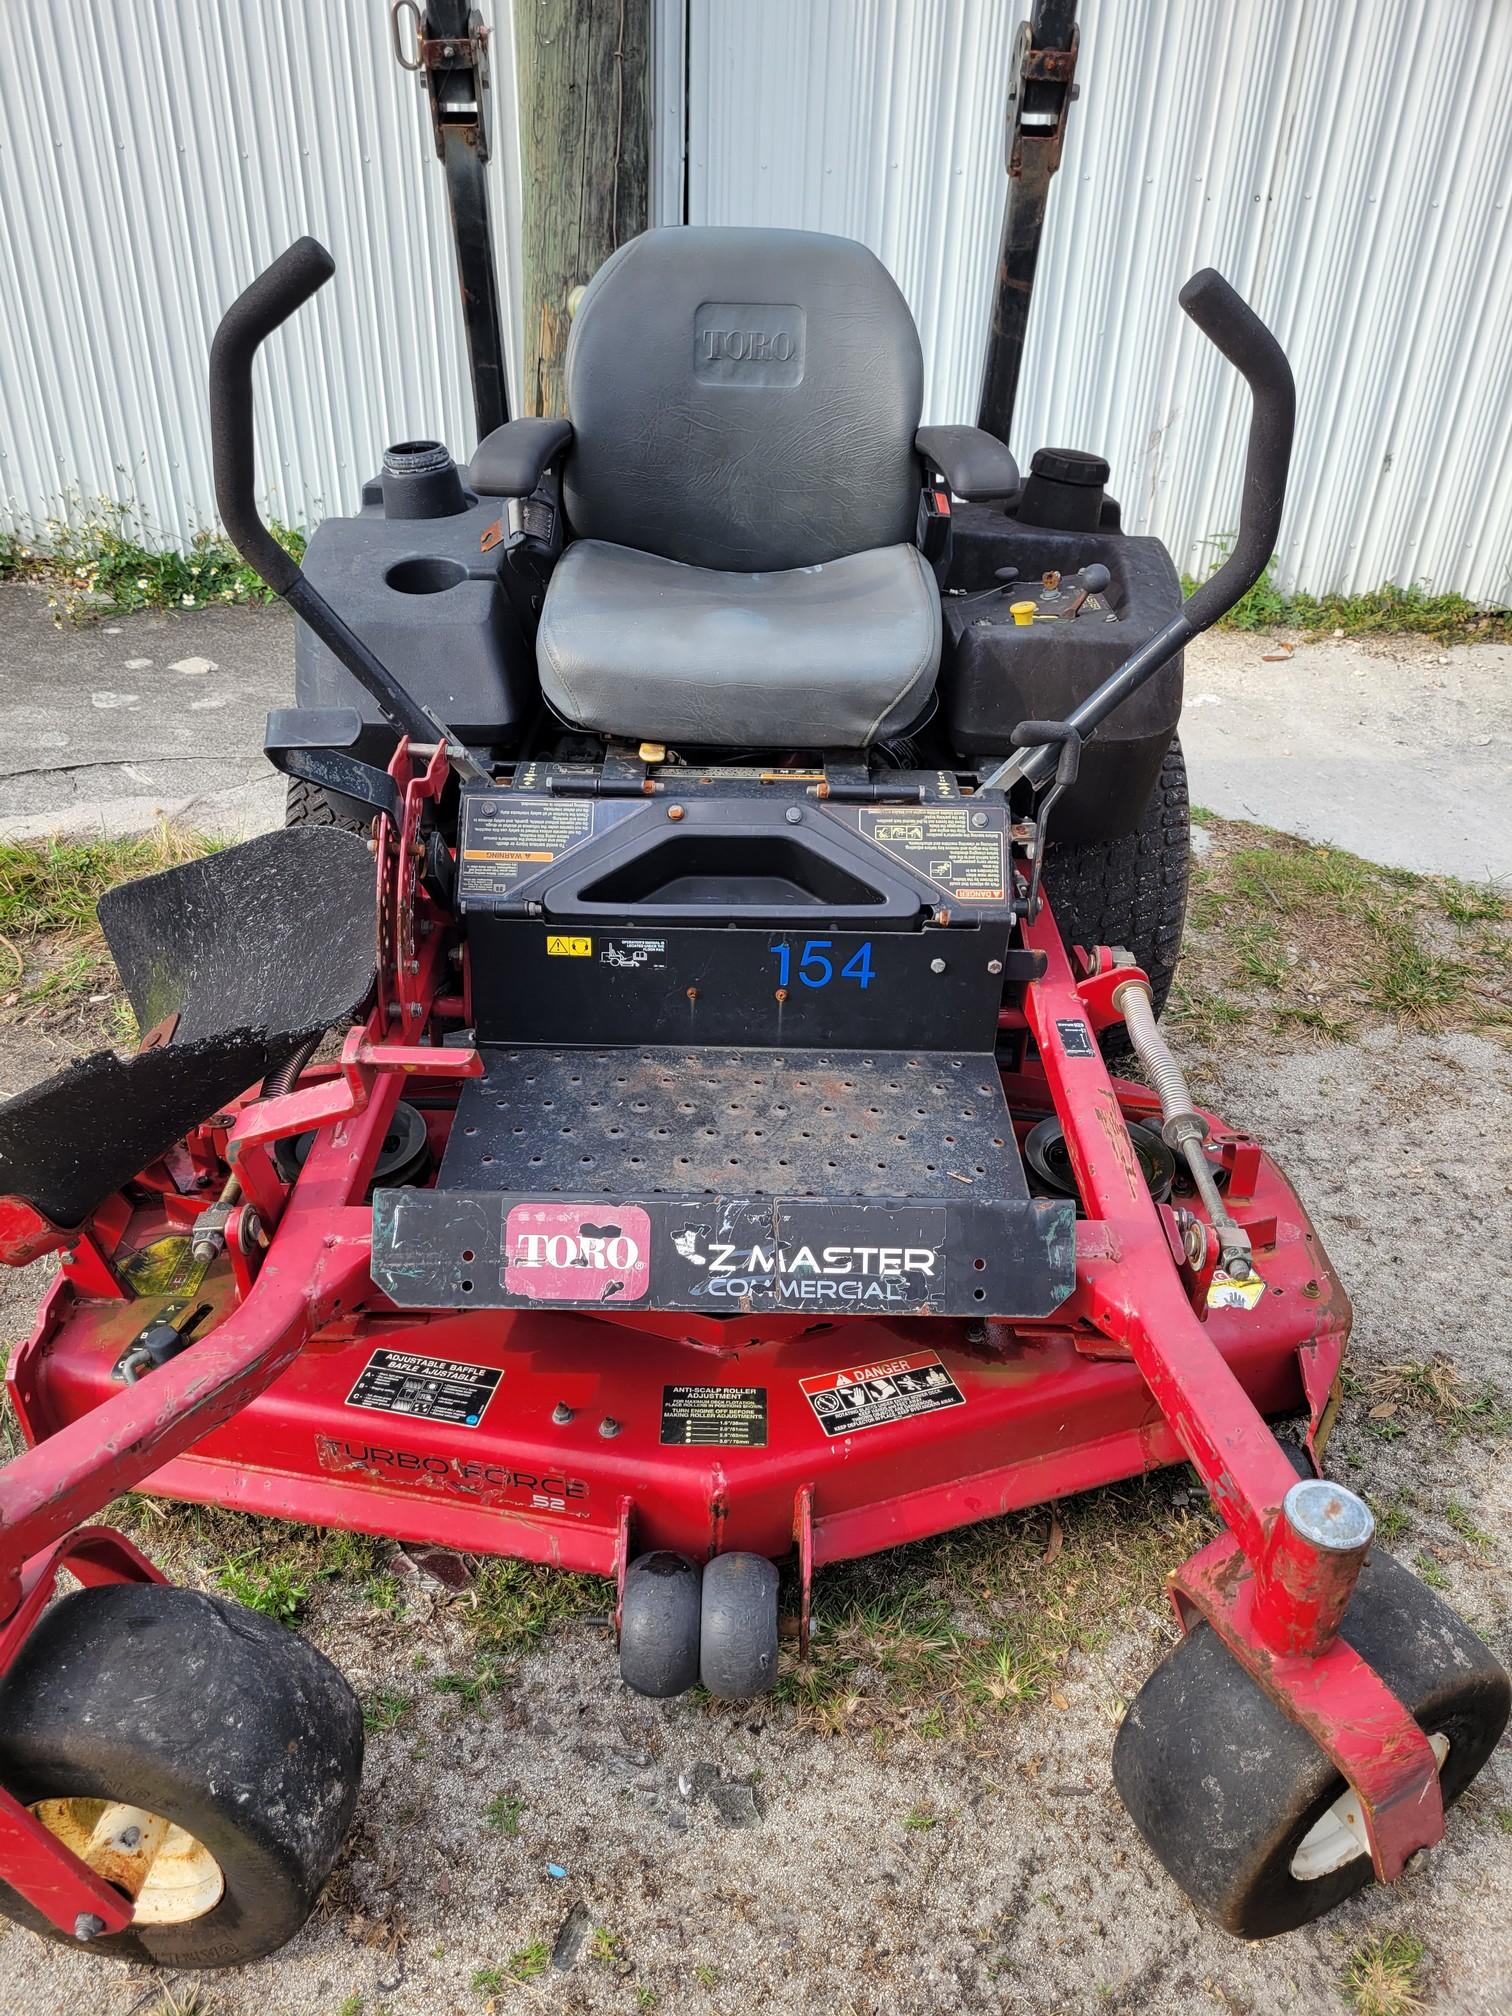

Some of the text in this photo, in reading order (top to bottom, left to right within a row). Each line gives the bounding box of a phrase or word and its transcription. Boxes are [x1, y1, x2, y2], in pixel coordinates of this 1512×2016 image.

[702, 330, 796, 362] TORO
[770, 940, 876, 988] 154
[518, 1234, 638, 1269] TORO
[708, 1244, 935, 1275] Z MASTER
[386, 1354, 486, 1376] ADJUSTABLE BAFFLE
[388, 1361, 478, 1382] BAFLE AJUSTABLE
[853, 1360, 911, 1381] DANGER
[326, 1440, 586, 1499] TURBO FORCE
[532, 1495, 566, 1511] 52
